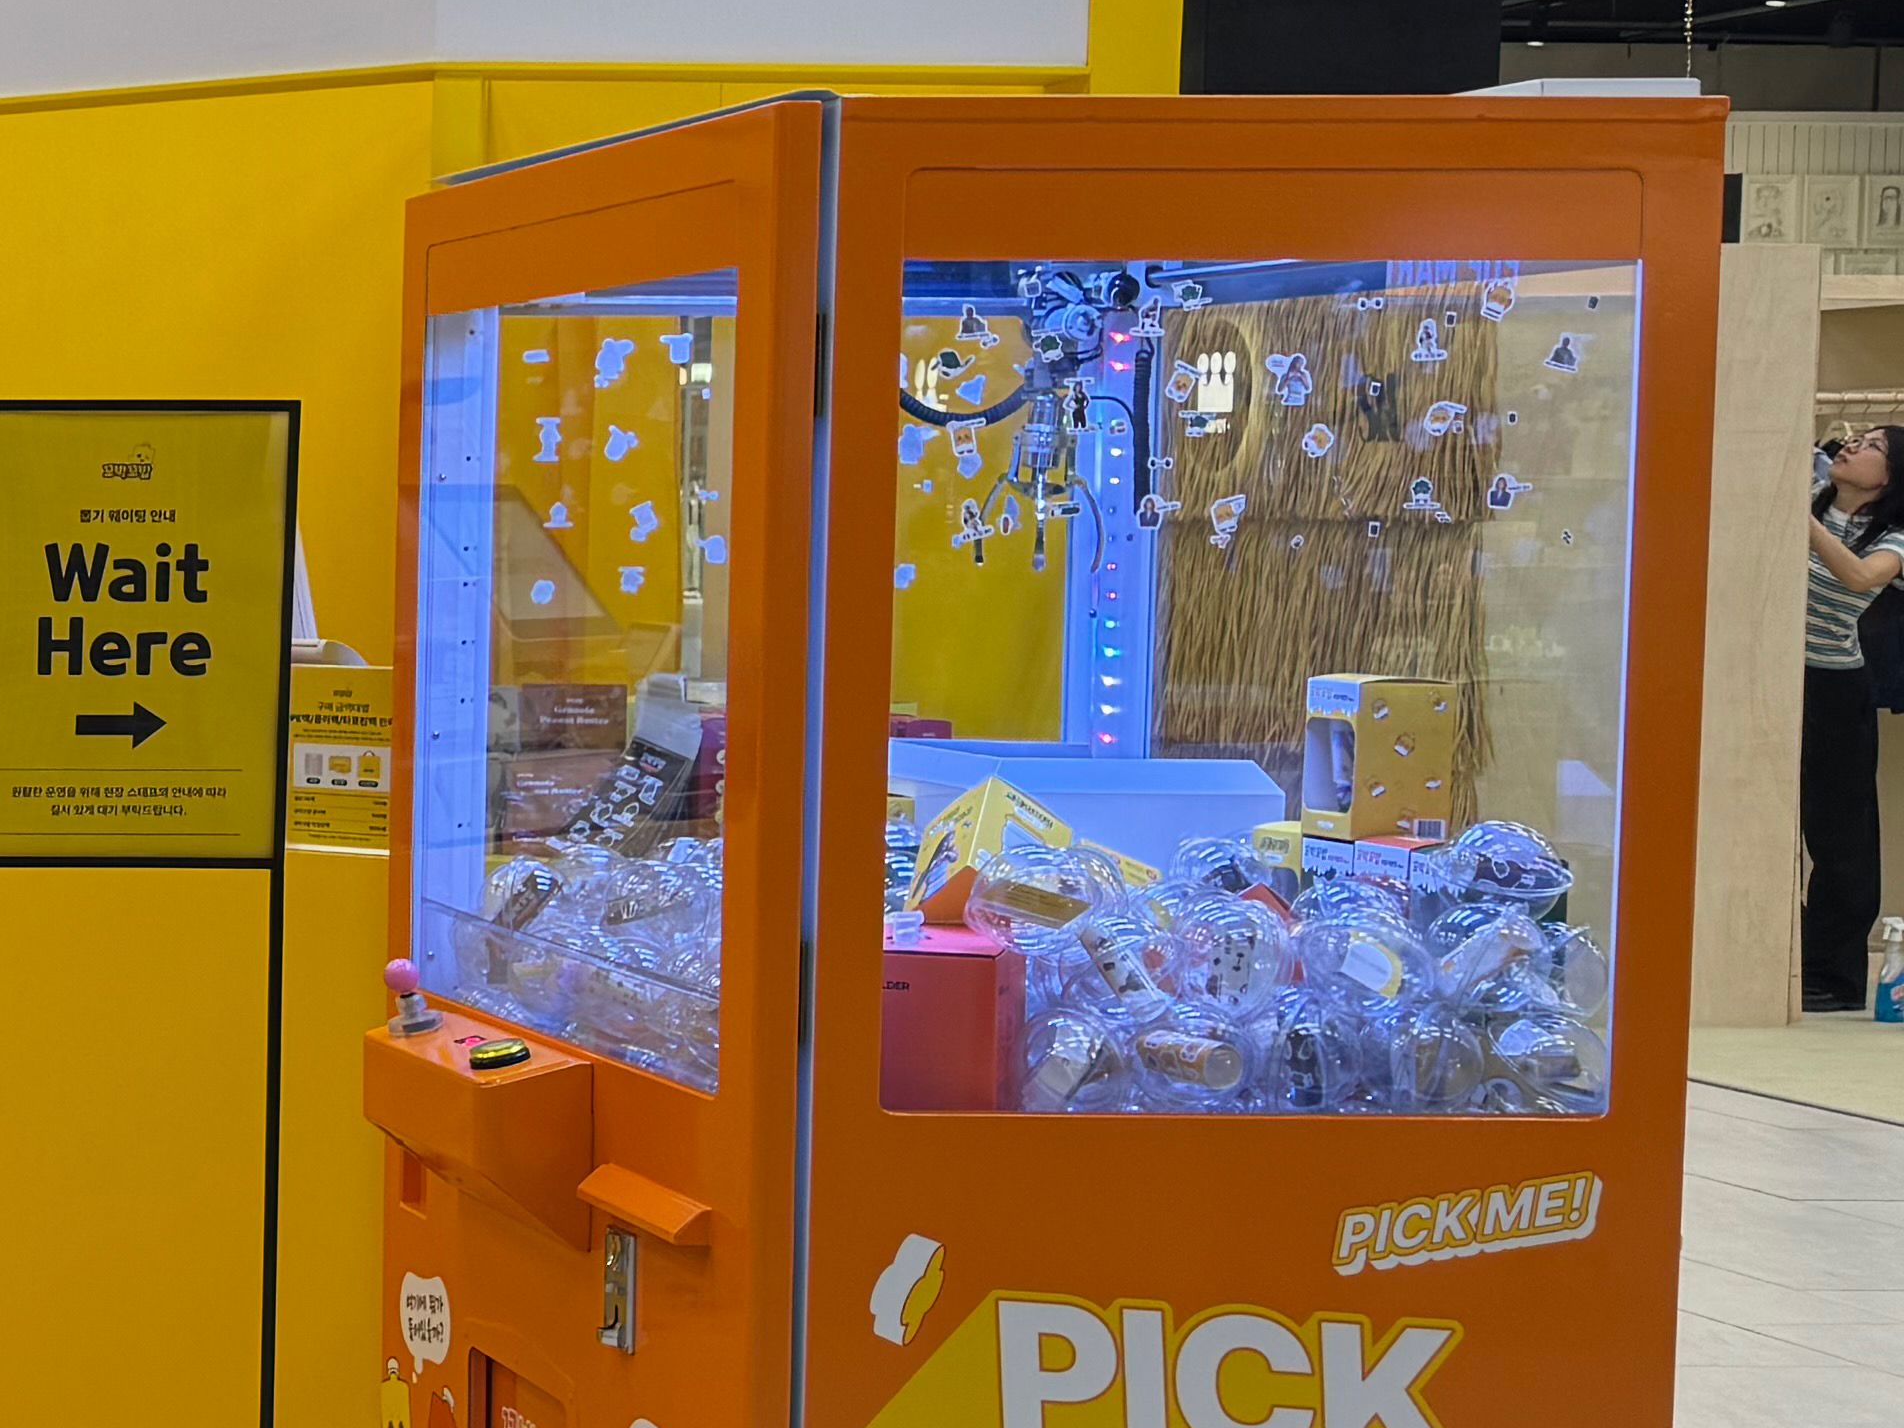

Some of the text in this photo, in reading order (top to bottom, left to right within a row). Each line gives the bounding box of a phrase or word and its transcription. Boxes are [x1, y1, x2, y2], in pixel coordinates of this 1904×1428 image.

[150, 509, 176, 523] 안내
[44, 542, 210, 603] Wait
[36, 617, 212, 677] Here
[1338, 1177, 1589, 1260] PICK ME!
